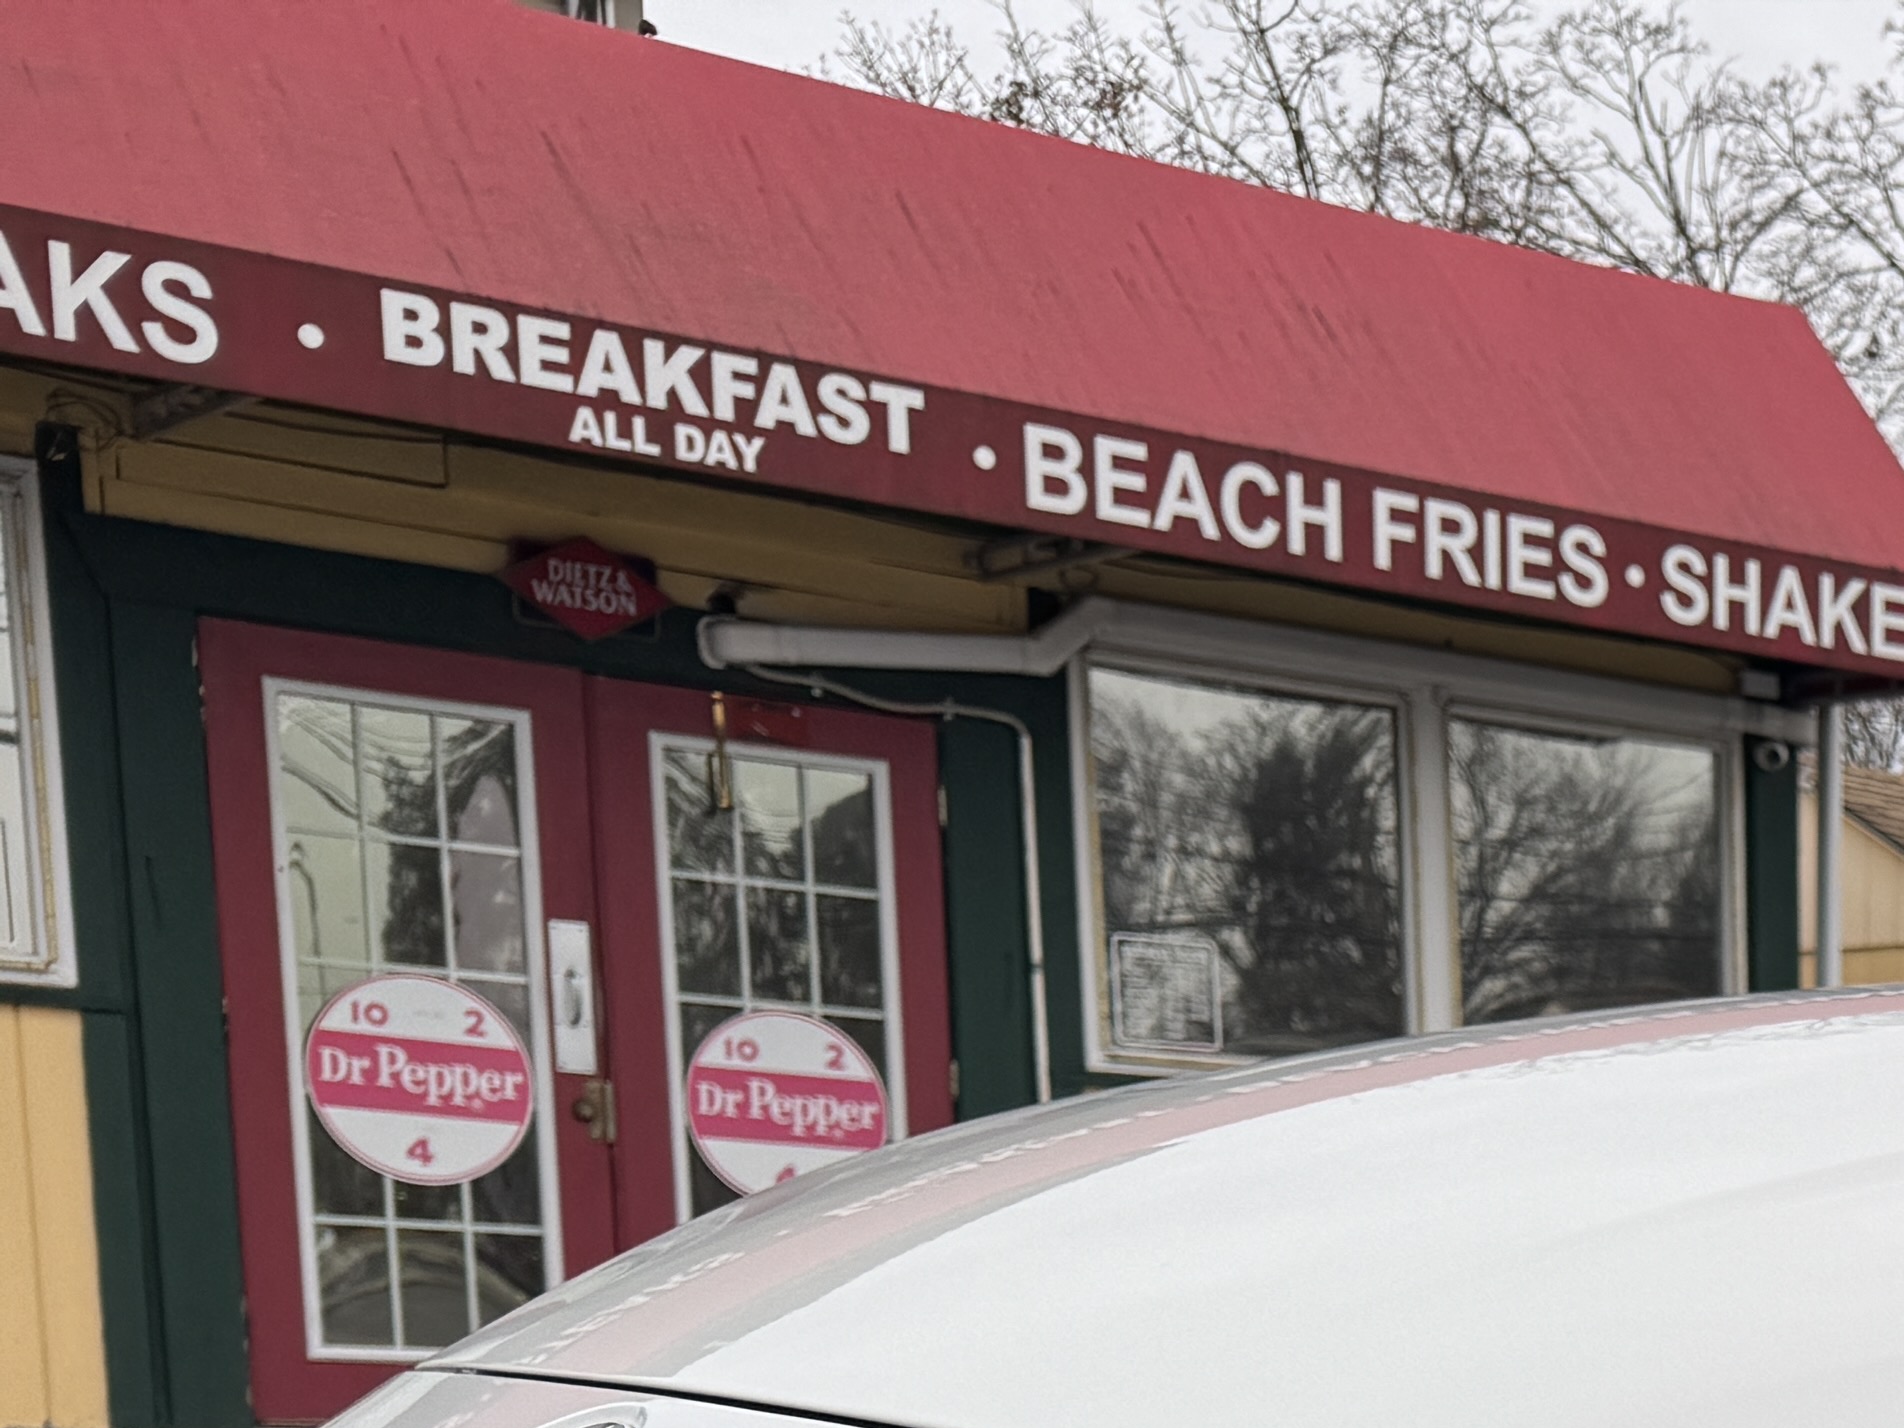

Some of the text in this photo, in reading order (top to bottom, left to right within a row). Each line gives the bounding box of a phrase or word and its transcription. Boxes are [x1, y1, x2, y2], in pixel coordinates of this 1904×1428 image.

[379, 287, 926, 455] BREAKFAST
[1023, 422, 1343, 562] BEACH
[1372, 487, 1609, 608] FRIES
[568, 405, 765, 473] ALL DAY
[547, 557, 613, 591] DIETZ
[530, 577, 637, 617] WATSON
[350, 1001, 488, 1038] 10 2
[723, 1037, 847, 1071] 10 2
[317, 1042, 524, 1107] Dr Pepper
[694, 1076, 881, 1137] Dr Pepper
[406, 1135, 435, 1167] 4
